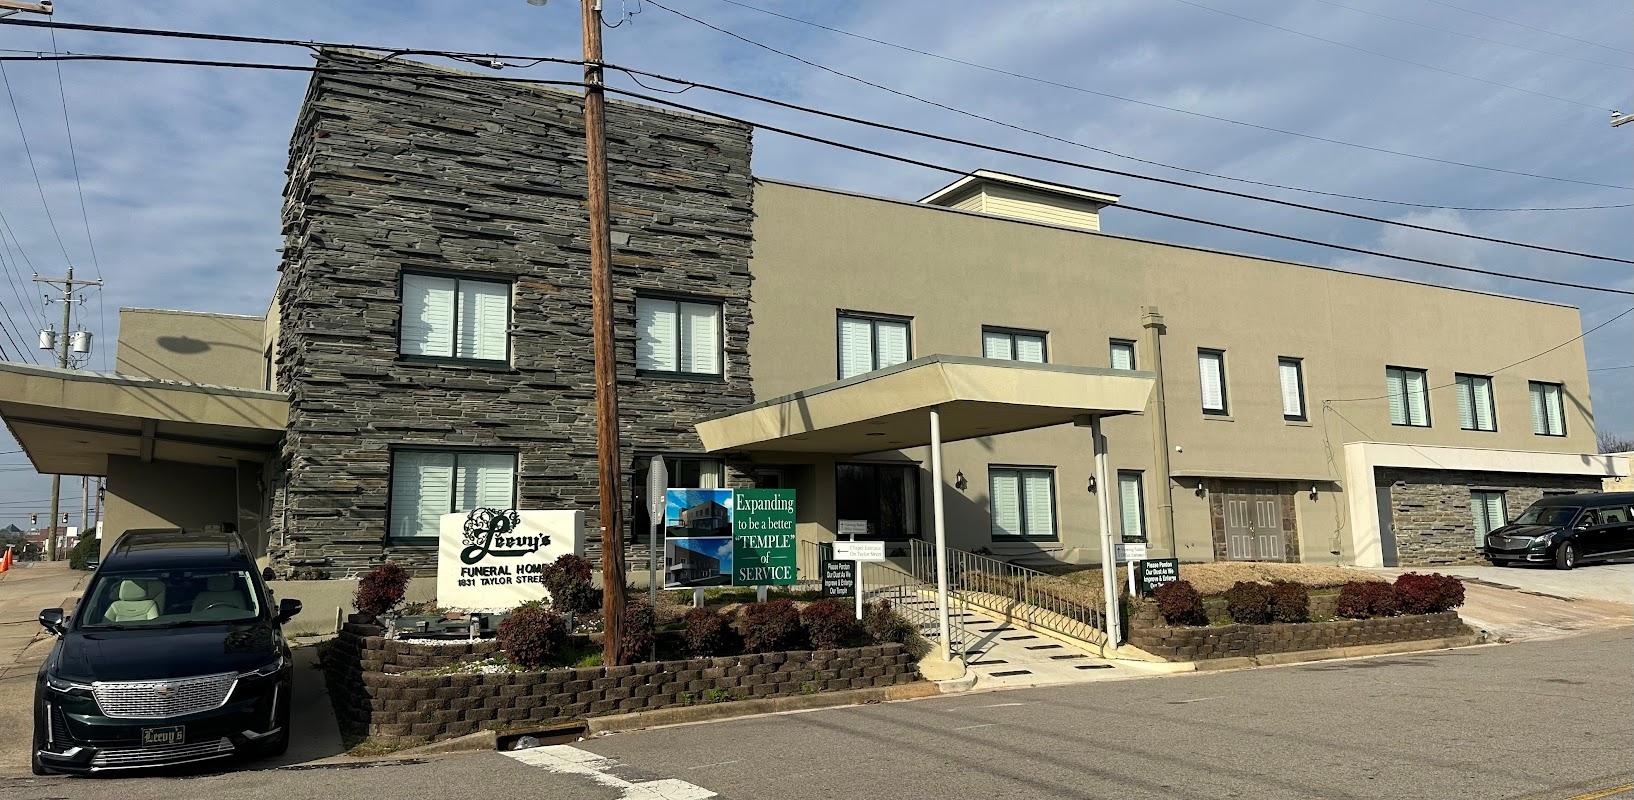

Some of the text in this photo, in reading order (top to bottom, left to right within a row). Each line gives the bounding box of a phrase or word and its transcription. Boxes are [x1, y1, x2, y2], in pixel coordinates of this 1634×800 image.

[736, 493, 794, 515] Expanding
[738, 516, 793, 530] to be a better
[460, 512, 551, 565] Leevy's
[760, 551, 771, 564] of
[460, 565, 512, 578] FUNERAL
[739, 565, 792, 581] SERVICE
[458, 575, 546, 587] 1831 TAYLOR STREE
